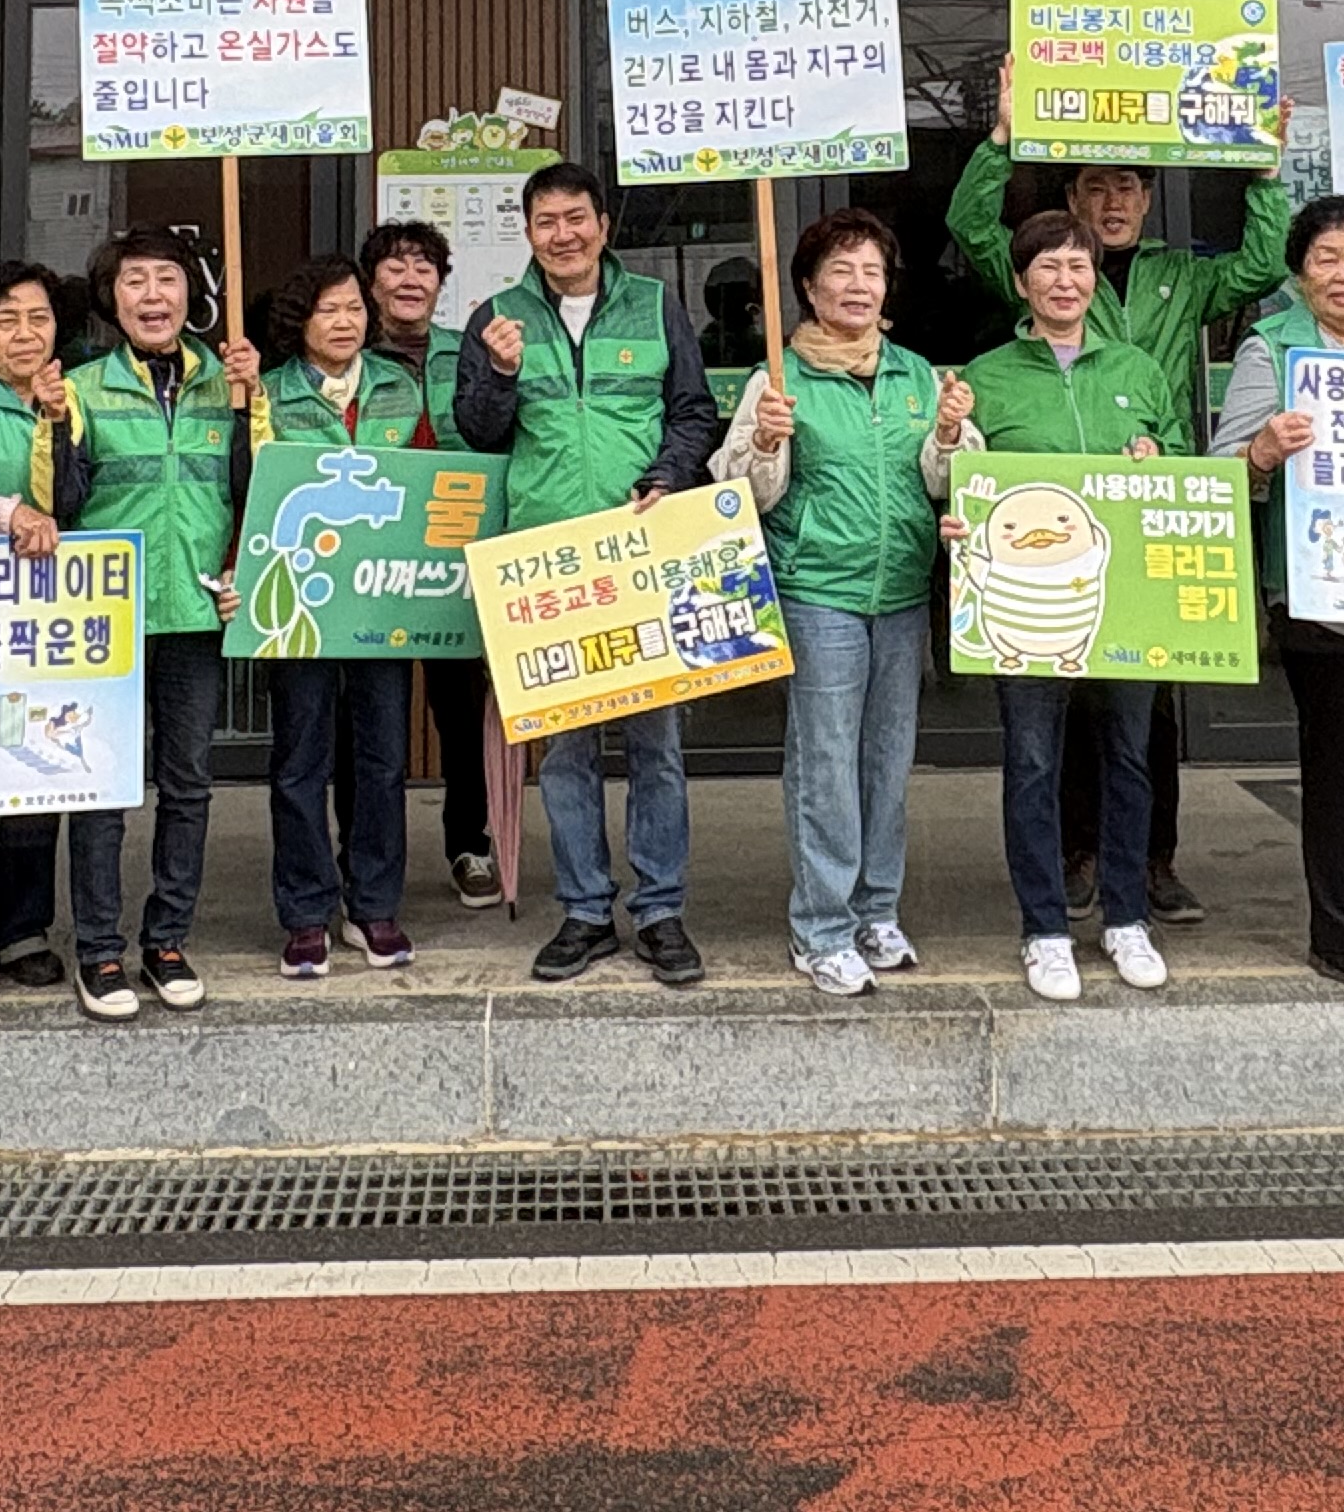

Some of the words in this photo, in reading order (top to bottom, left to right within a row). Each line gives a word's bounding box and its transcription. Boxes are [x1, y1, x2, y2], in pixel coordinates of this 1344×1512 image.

[628, 6, 690, 39] 버스,
[701, 0, 790, 36] 지하철,
[1029, 6, 1131, 34] 비닐봉지
[1143, 9, 1193, 34] 대신
[93, 31, 209, 64] 절약하고
[217, 29, 360, 62] 온실가스도
[623, 52, 704, 88] 걷기로
[712, 50, 736, 83] 내
[744, 47, 798, 82] 몸과
[807, 41, 886, 78] 지구의
[1029, 39, 1106, 66] 에코백
[1118, 42, 1218, 67] 이용해요
[93, 77, 210, 112] 줄입니다
[1035, 88, 1089, 121] 나의
[1093, 89, 1172, 125] 지구를
[1178, 91, 1256, 126] 구해줘
[626, 100, 705, 136] 건강을
[715, 95, 794, 131] 지킨다
[198, 122, 359, 148] 보성군새마을회
[731, 140, 894, 167] 보성군새마을회
[1080, 473, 1176, 503] 사용하지
[1183, 476, 1234, 505] 않는
[425, 471, 488, 548] 물
[1140, 508, 1236, 539] 전자기기
[496, 544, 582, 588] 자가용
[594, 526, 650, 564] 대신
[1144, 543, 1238, 580] 플러그
[505, 574, 619, 625] 대중교통
[631, 544, 744, 594] 이용해요
[1177, 584, 1239, 622] 뽑기
[517, 640, 579, 691] 나의
[579, 617, 669, 676] 지구를
[671, 598, 759, 651] 구해줘
